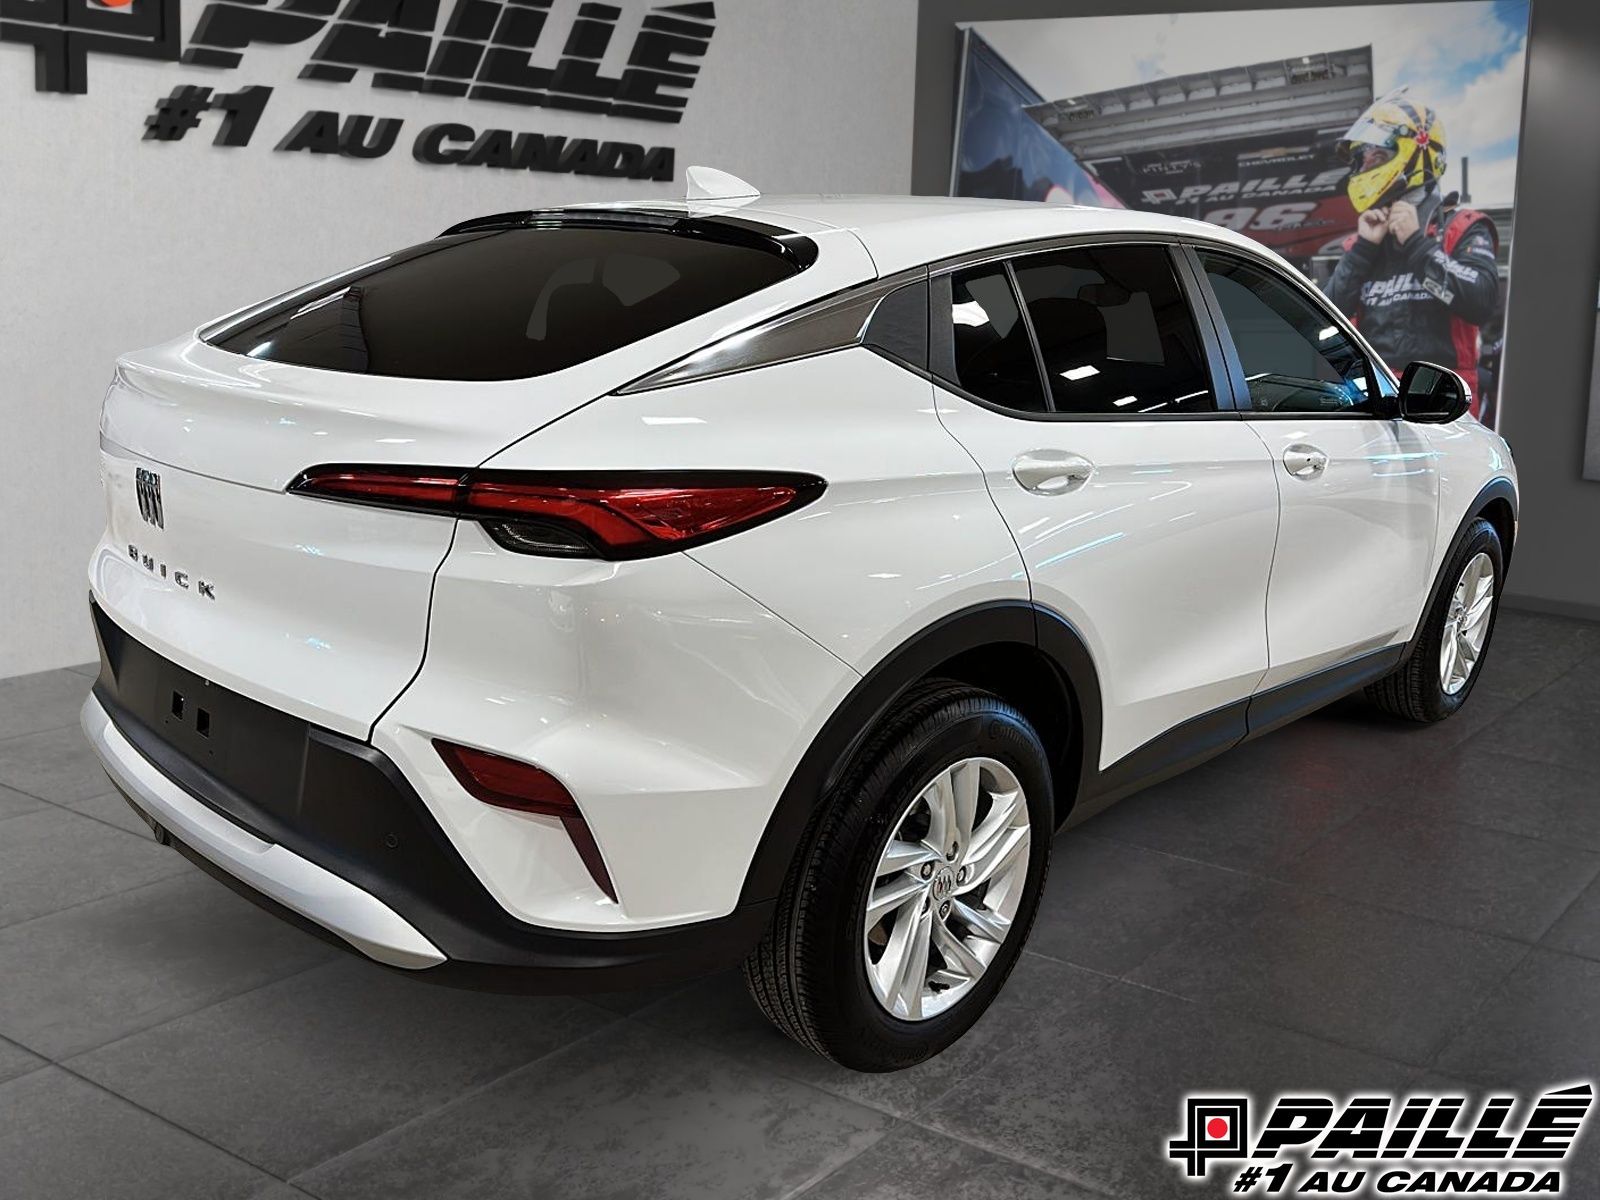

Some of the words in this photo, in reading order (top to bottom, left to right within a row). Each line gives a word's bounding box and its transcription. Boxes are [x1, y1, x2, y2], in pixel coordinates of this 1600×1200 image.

[142, 85, 274, 147] #1
[273, 110, 403, 158] AU
[412, 123, 676, 181] CANADA
[1238, 154, 1316, 168] CHEVROLET
[1241, 185, 1336, 199] CANADA
[1203, 202, 1318, 231] 96
[128, 544, 216, 601] BUICK
